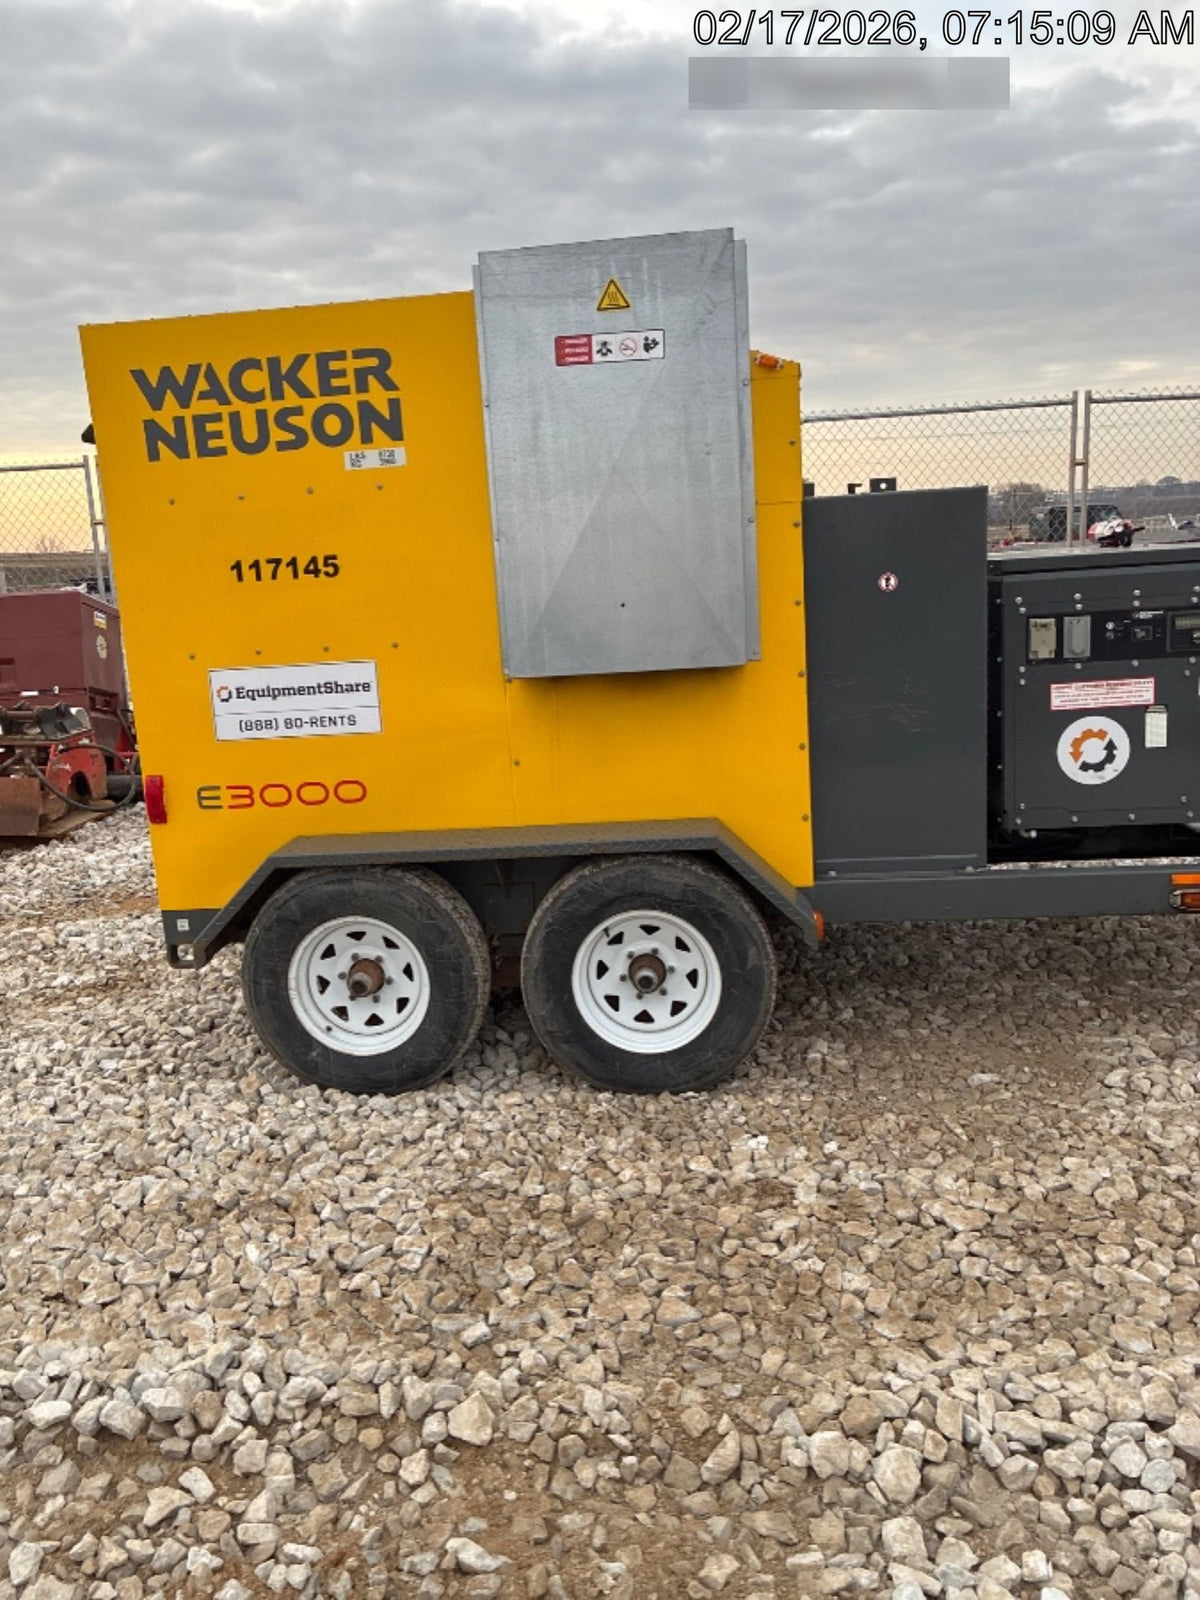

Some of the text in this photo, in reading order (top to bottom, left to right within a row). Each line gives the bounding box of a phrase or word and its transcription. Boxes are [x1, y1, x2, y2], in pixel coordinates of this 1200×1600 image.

[129, 347, 400, 412] WACKER
[142, 398, 404, 463] NEUSON
[230, 554, 340, 583] 117145
[235, 680, 371, 702] EquipmentShare
[238, 714, 357, 733] (888) 80-RENTS
[197, 780, 367, 810] E3000
